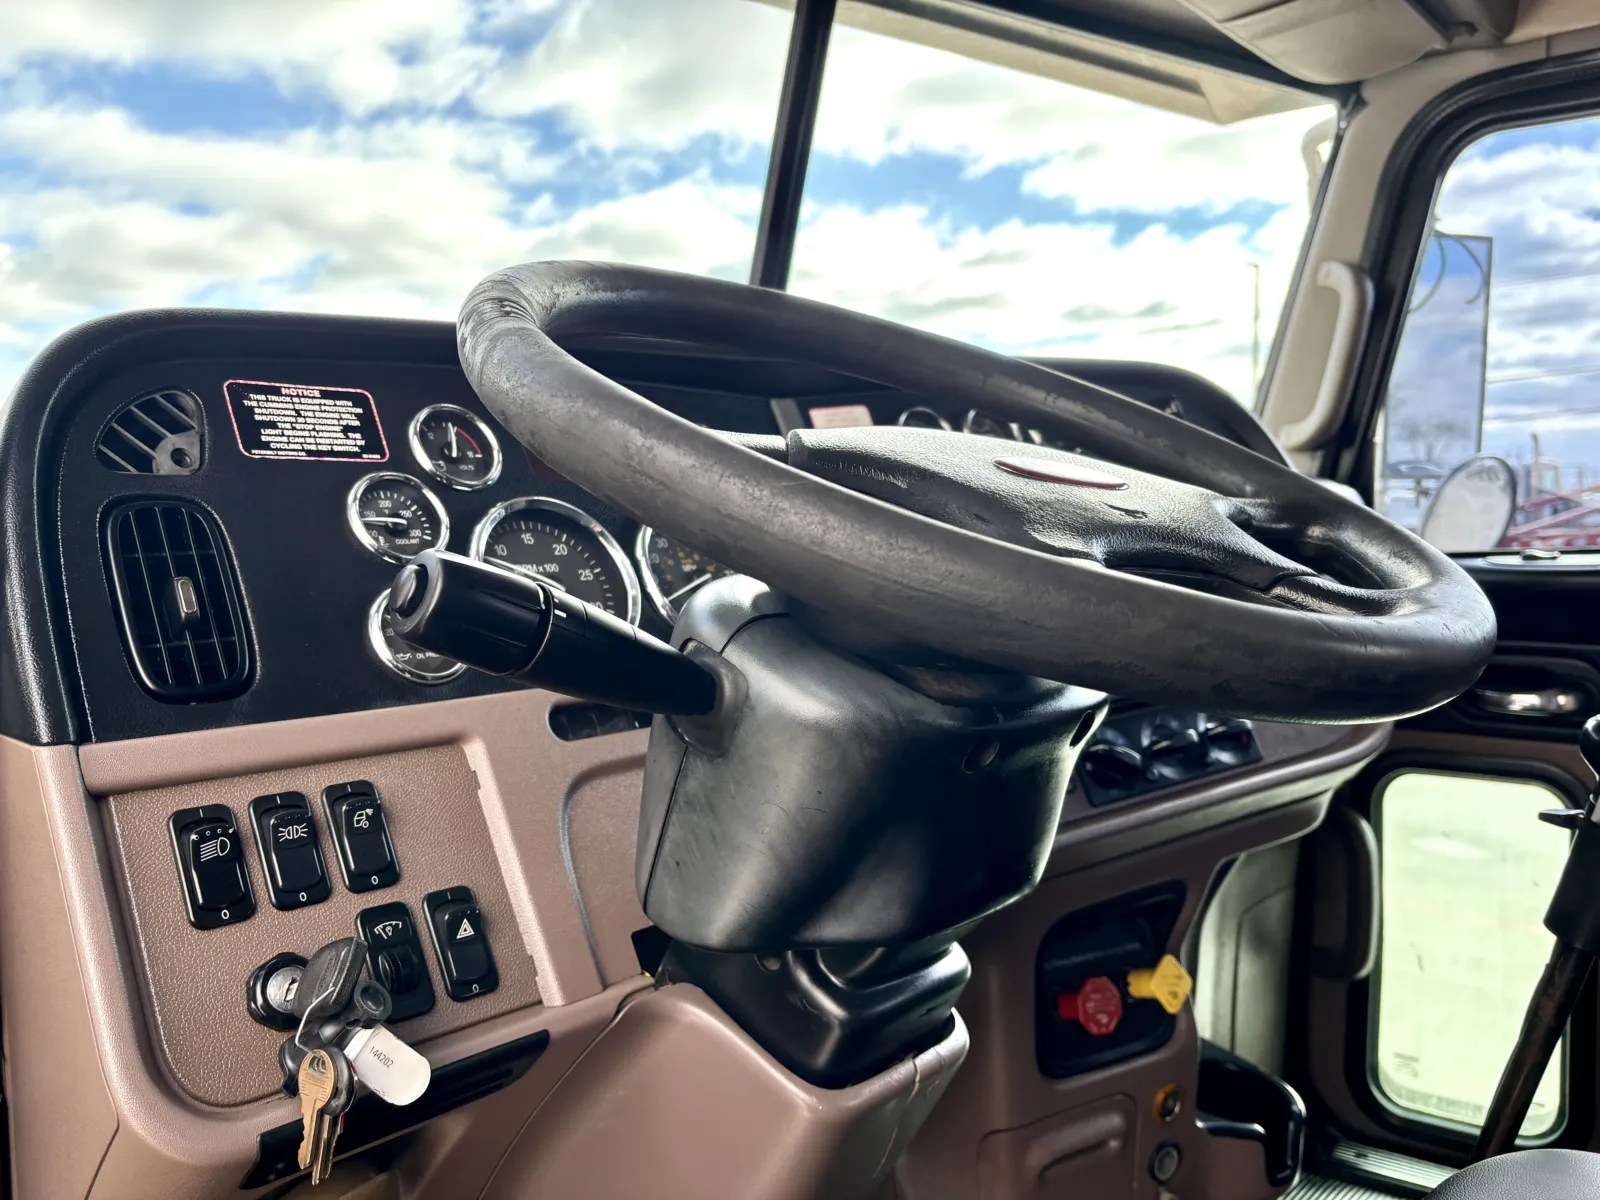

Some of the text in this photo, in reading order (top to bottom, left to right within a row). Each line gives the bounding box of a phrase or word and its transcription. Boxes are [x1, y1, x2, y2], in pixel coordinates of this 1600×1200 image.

[281, 387, 321, 397] NOTICE
[249, 393, 266, 401] THIS
[300, 397, 335, 406] EQUIPPED
[258, 401, 294, 409] CUMMINS
[294, 403, 321, 411] ENGINE
[321, 405, 363, 414] PROTECTION
[299, 410, 316, 418] THE
[254, 414, 296, 423] SHUTDOWN
[305, 418, 339, 426] SECONDS
[260, 435, 289, 443] ENGINE
[315, 438, 356, 446] RESTARTED
[347, 432, 363, 440] THE
[270, 442, 302, 450] CYCLING
[302, 443, 318, 451] THE
[378, 500, 392, 508] 200
[399, 510, 413, 518] 250
[409, 529, 422, 537] 300
[521, 533, 535, 545] 15
[656, 537, 669, 549] 30
[494, 544, 508, 556] 10
[552, 543, 568, 556] 20
[543, 563, 560, 573] 100
[578, 569, 594, 581] 25
[368, 1045, 395, 1069] 144202
